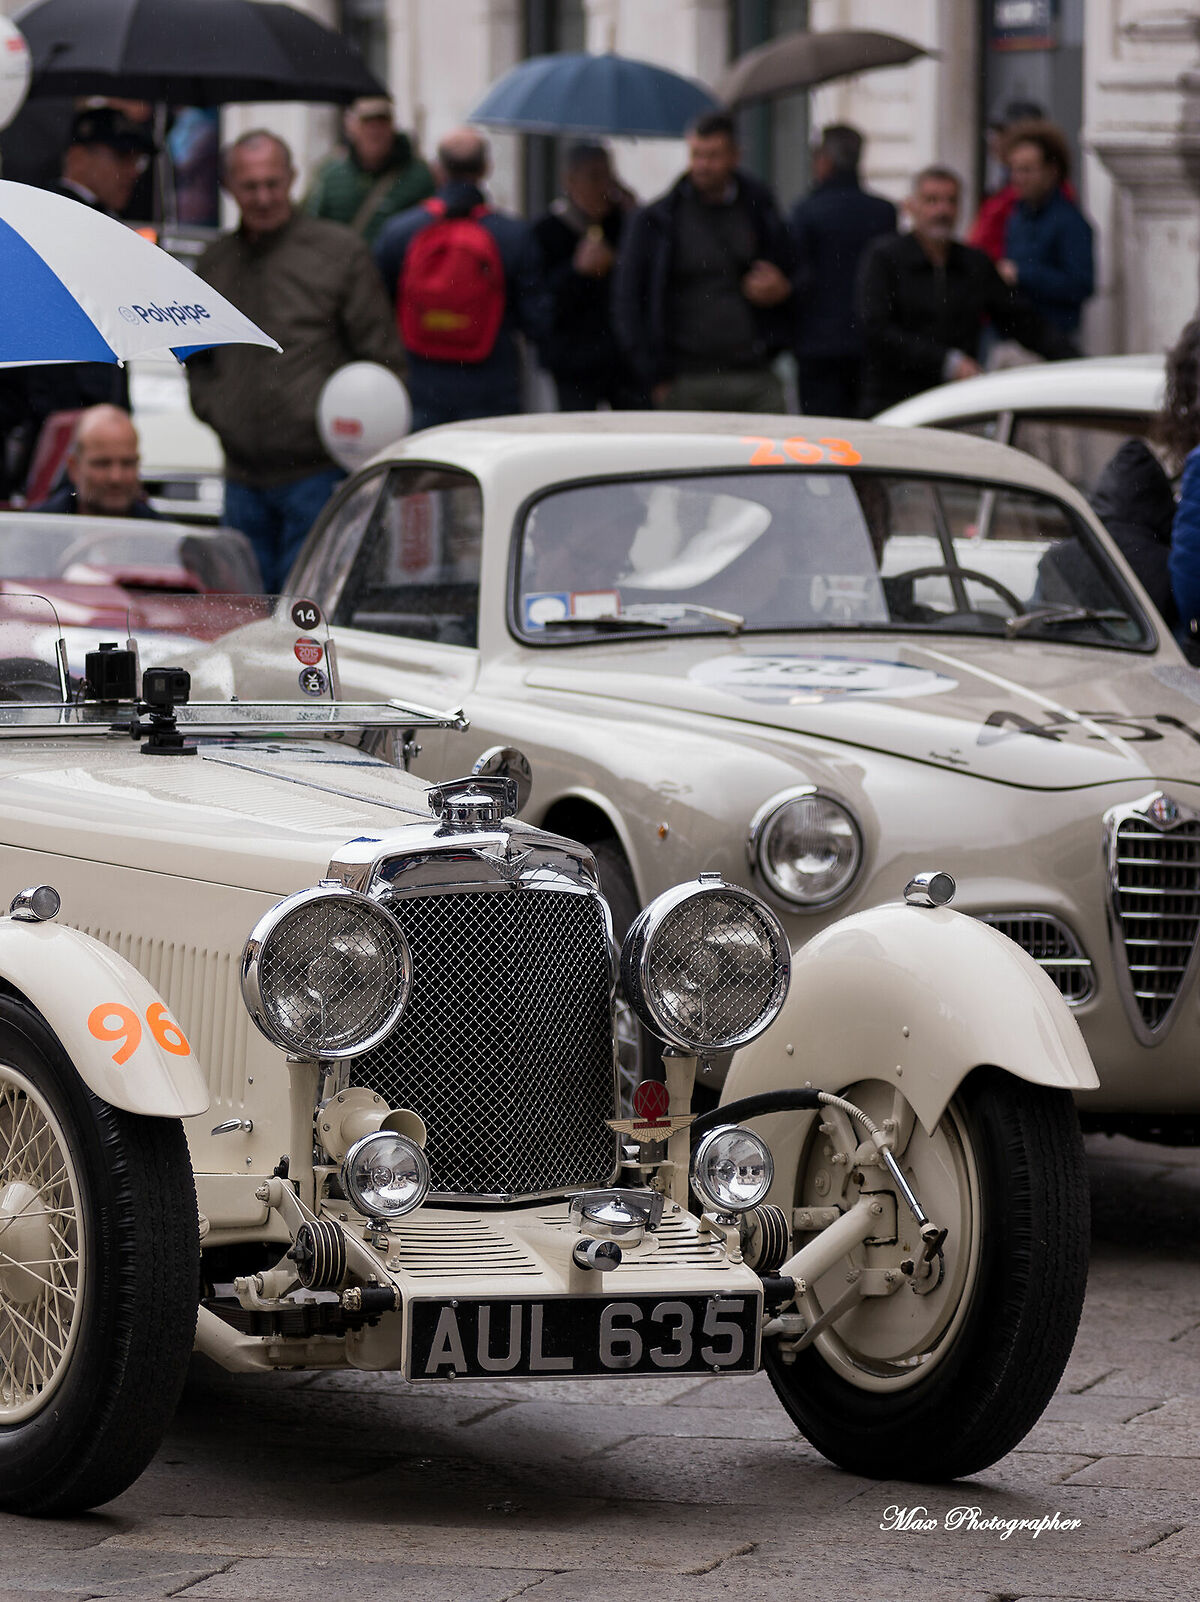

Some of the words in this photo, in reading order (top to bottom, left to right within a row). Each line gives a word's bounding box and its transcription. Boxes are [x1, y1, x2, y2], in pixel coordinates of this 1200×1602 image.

[131, 300, 211, 327] Polypipe
[739, 436, 863, 466] 263
[297, 609, 316, 623] 14
[299, 647, 319, 658] 2015
[87, 1002, 191, 1066] 96
[424, 1303, 574, 1374] AUL
[599, 1299, 746, 1370] 635
